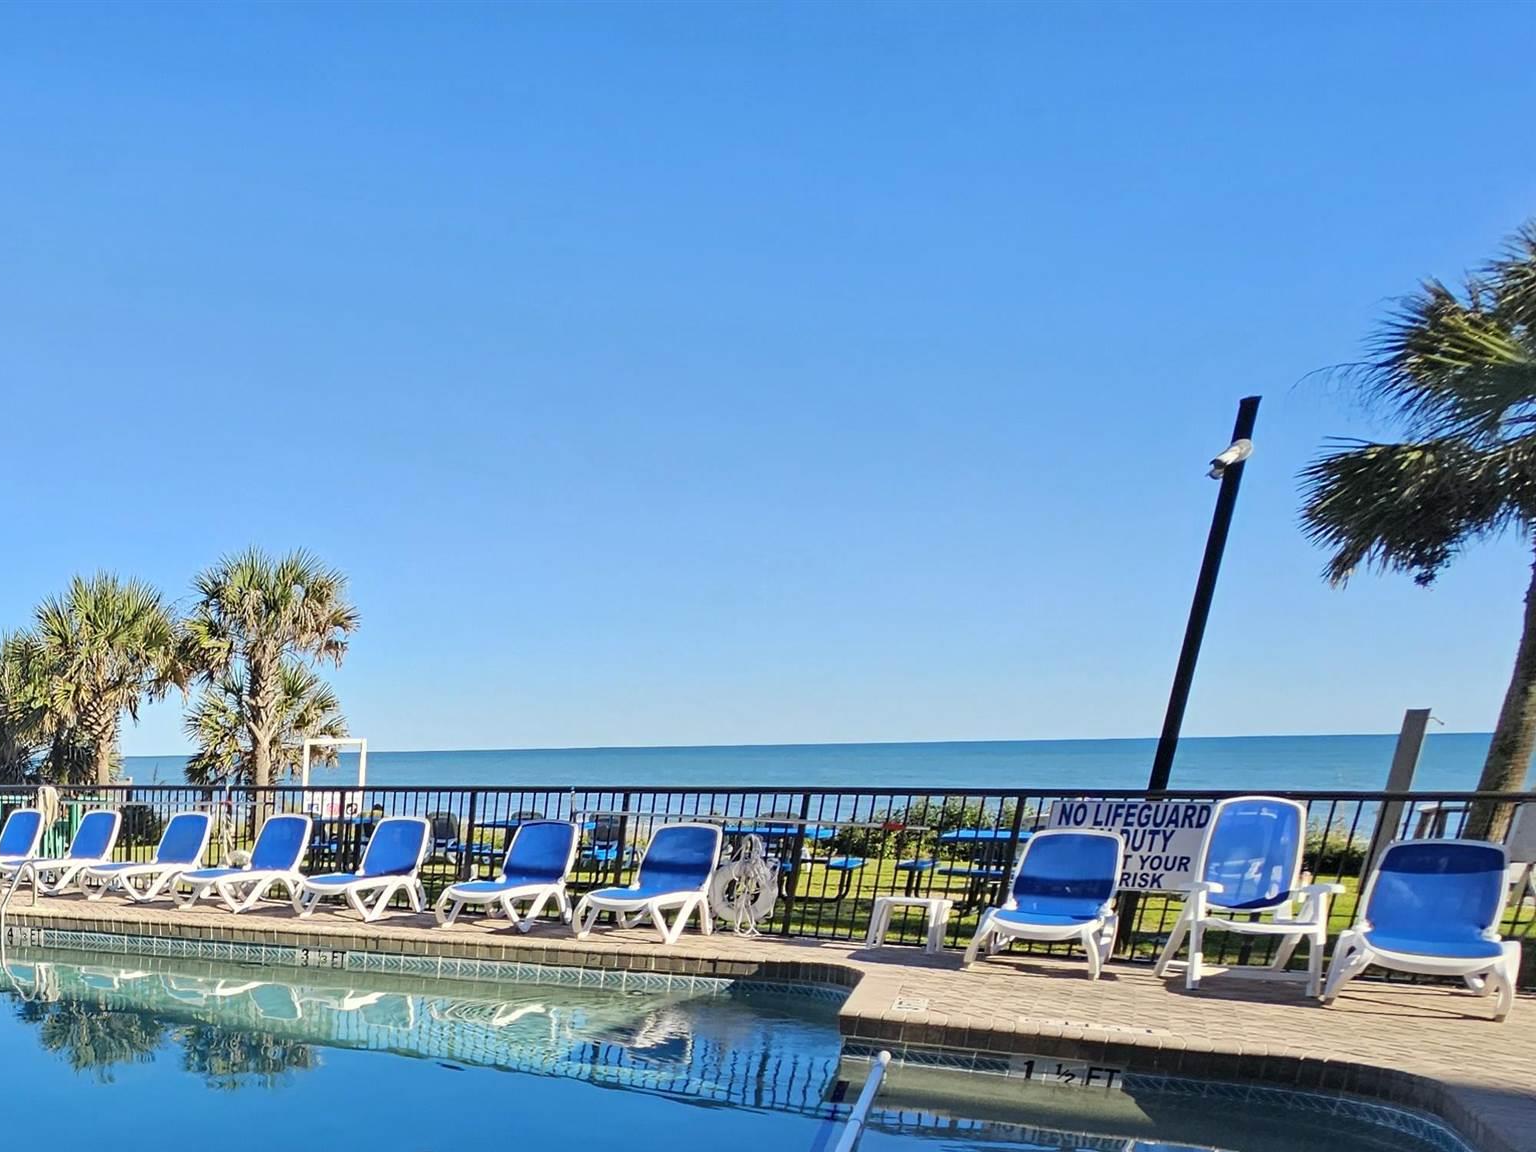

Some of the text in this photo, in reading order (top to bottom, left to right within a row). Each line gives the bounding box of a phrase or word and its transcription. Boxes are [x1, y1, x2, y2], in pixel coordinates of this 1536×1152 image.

[1057, 803, 1212, 829] NO LIFEGUARD
[1138, 855, 1191, 872] YOUR
[1118, 872, 1165, 888] RISK
[1024, 1060, 1035, 1080] 1
[1084, 1066, 1121, 1088] FT
